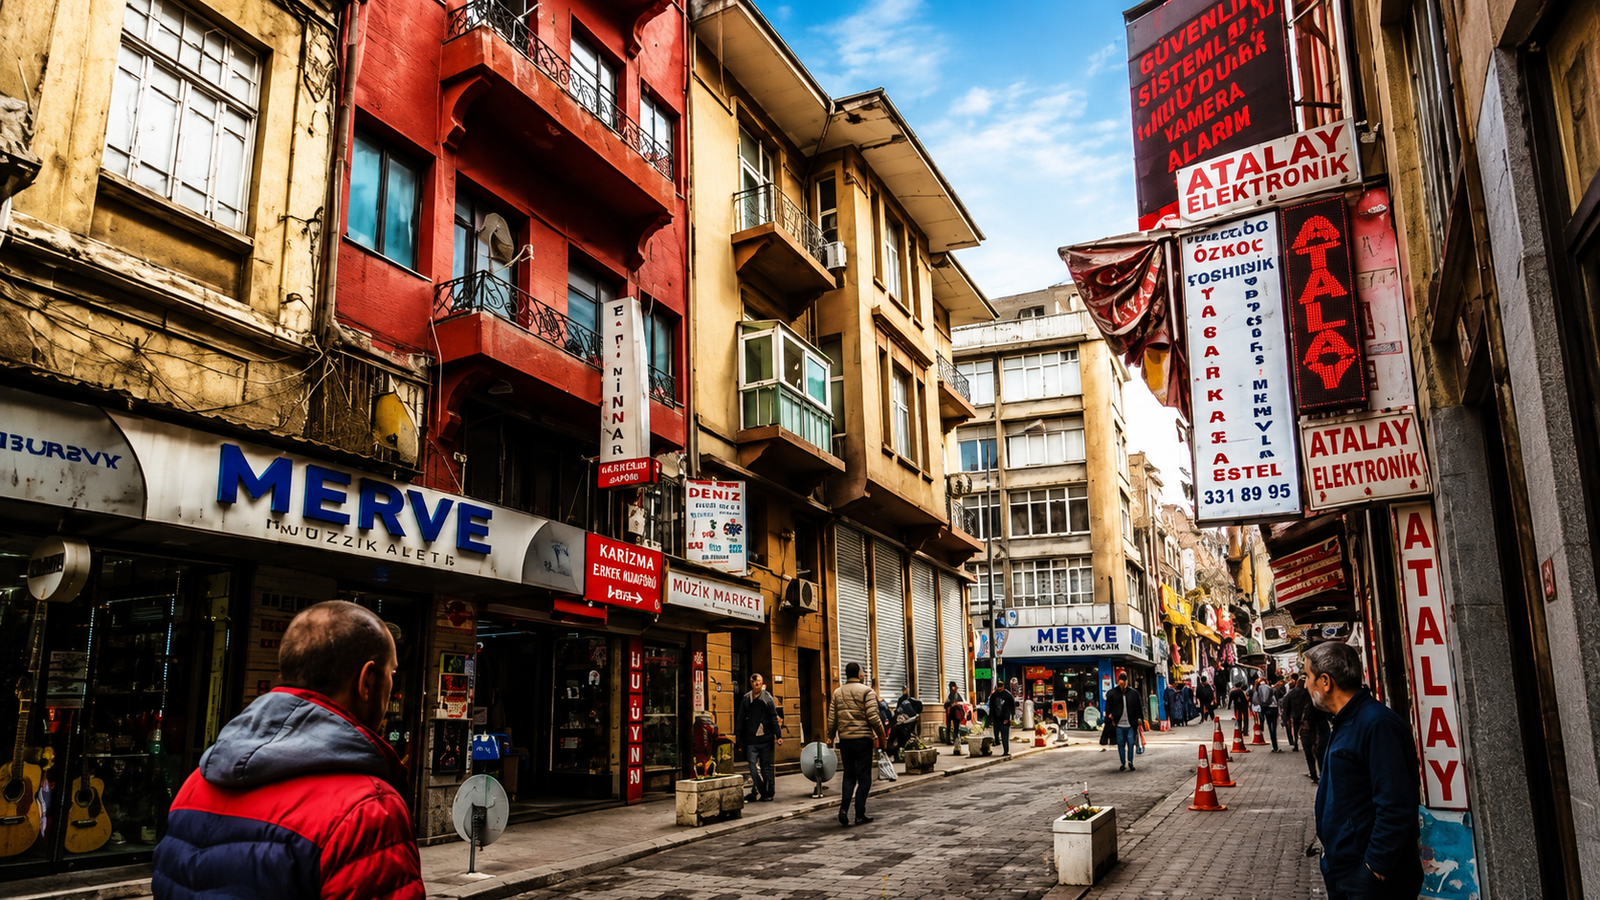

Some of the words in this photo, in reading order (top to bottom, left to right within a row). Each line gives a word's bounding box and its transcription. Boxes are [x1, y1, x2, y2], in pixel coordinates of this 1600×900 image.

[1164, 82, 1246, 143] YAMERA
[1186, 124, 1345, 196] ATALAY
[1187, 153, 1350, 215] ELEKTRONİK
[1309, 418, 1411, 459] ATALAY
[1312, 449, 1422, 492] ELEKTRONİK
[216, 443, 493, 555] MERVE
[689, 488, 740, 501] DENIZ
[1204, 487, 1235, 506] 331
[1240, 485, 1263, 502] 89
[1268, 483, 1291, 500] 95
[600, 543, 654, 571] KARİZMA
[673, 577, 710, 600] MÜZİK
[714, 589, 761, 612] MARKET
[1037, 626, 1117, 643] MERVE
[1404, 511, 1459, 802] ATALAY
